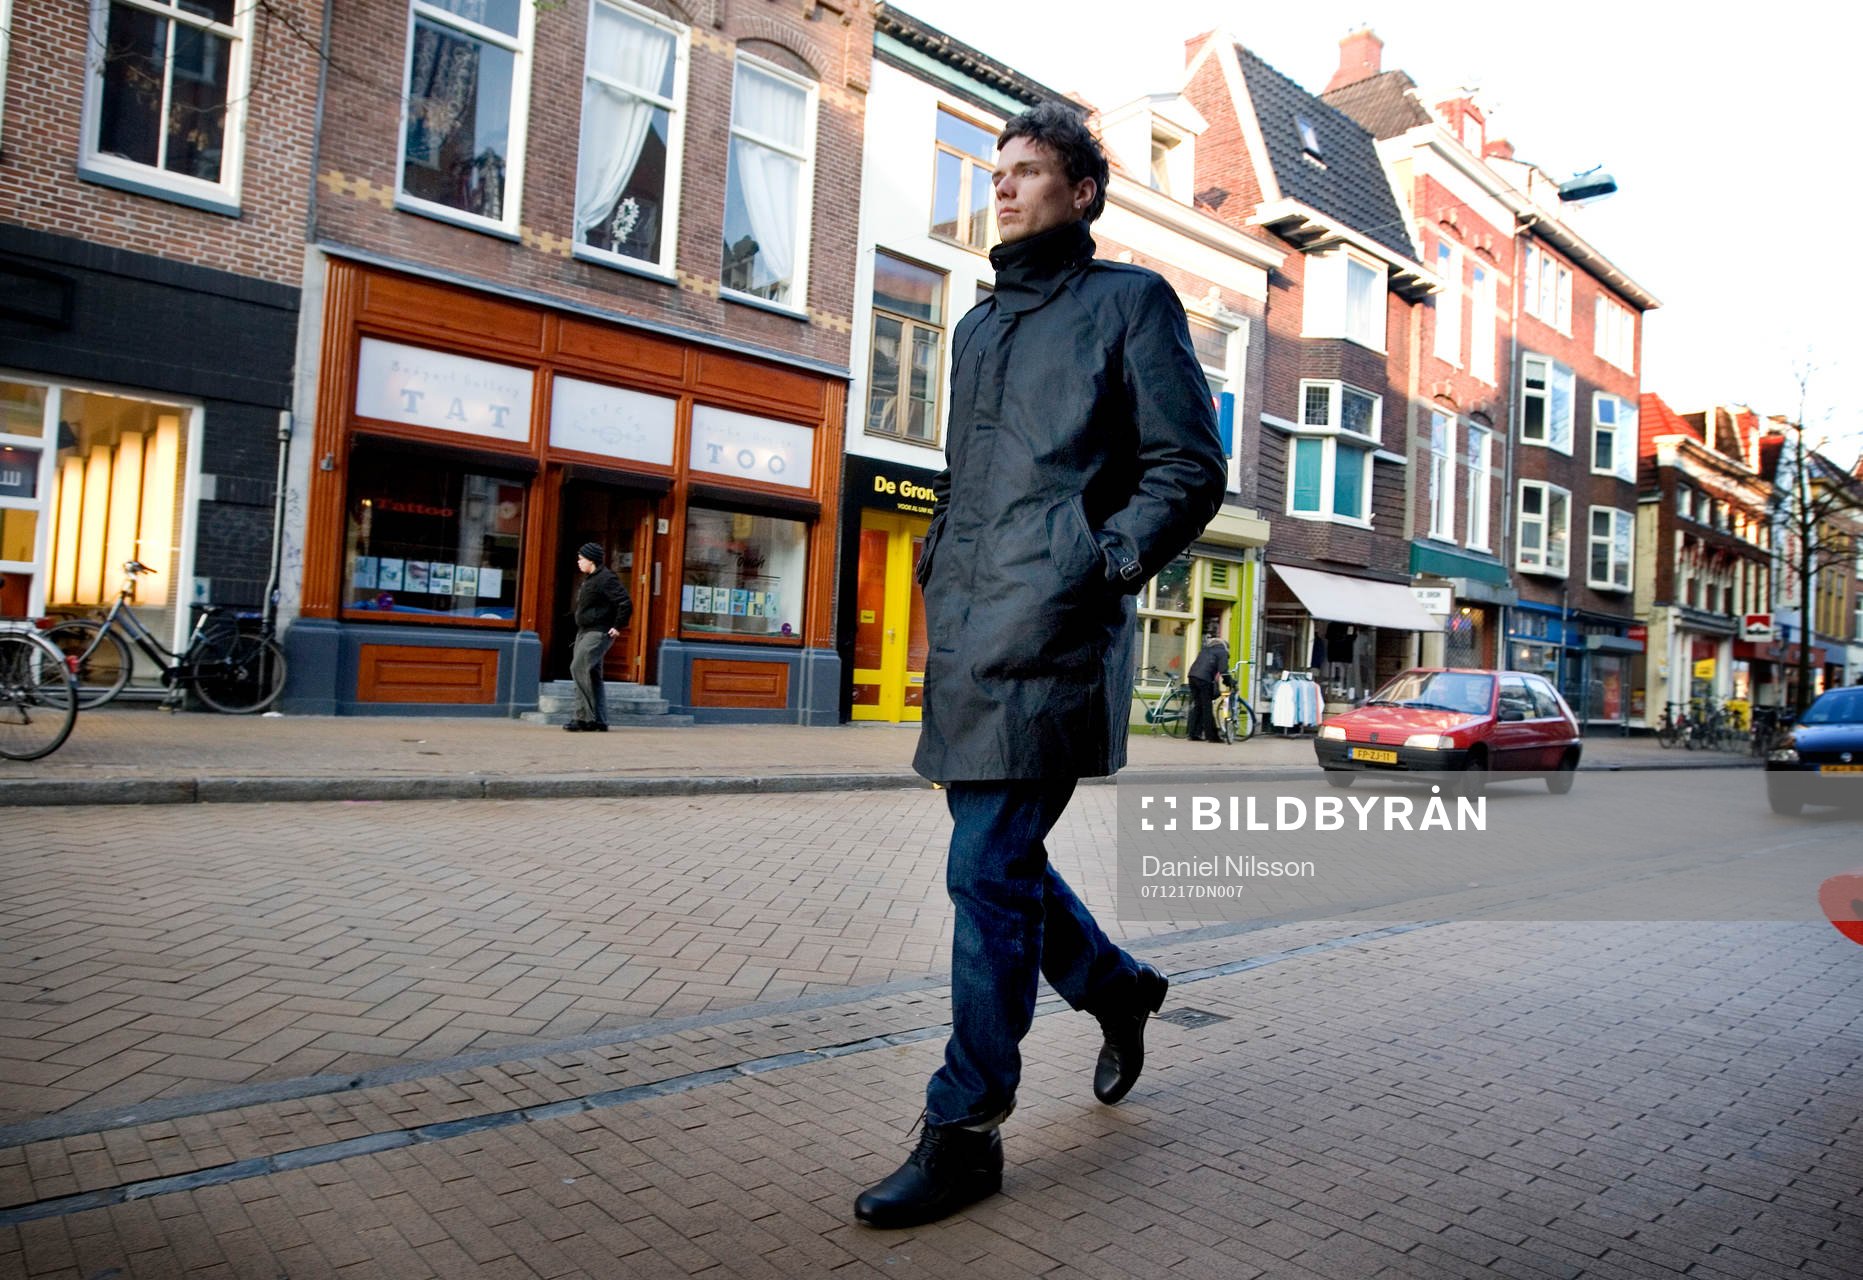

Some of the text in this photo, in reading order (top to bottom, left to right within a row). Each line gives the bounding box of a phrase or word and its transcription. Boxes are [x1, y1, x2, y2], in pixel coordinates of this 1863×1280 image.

[874, 475, 938, 501] De Gron
[376, 498, 454, 517] Tattoo
